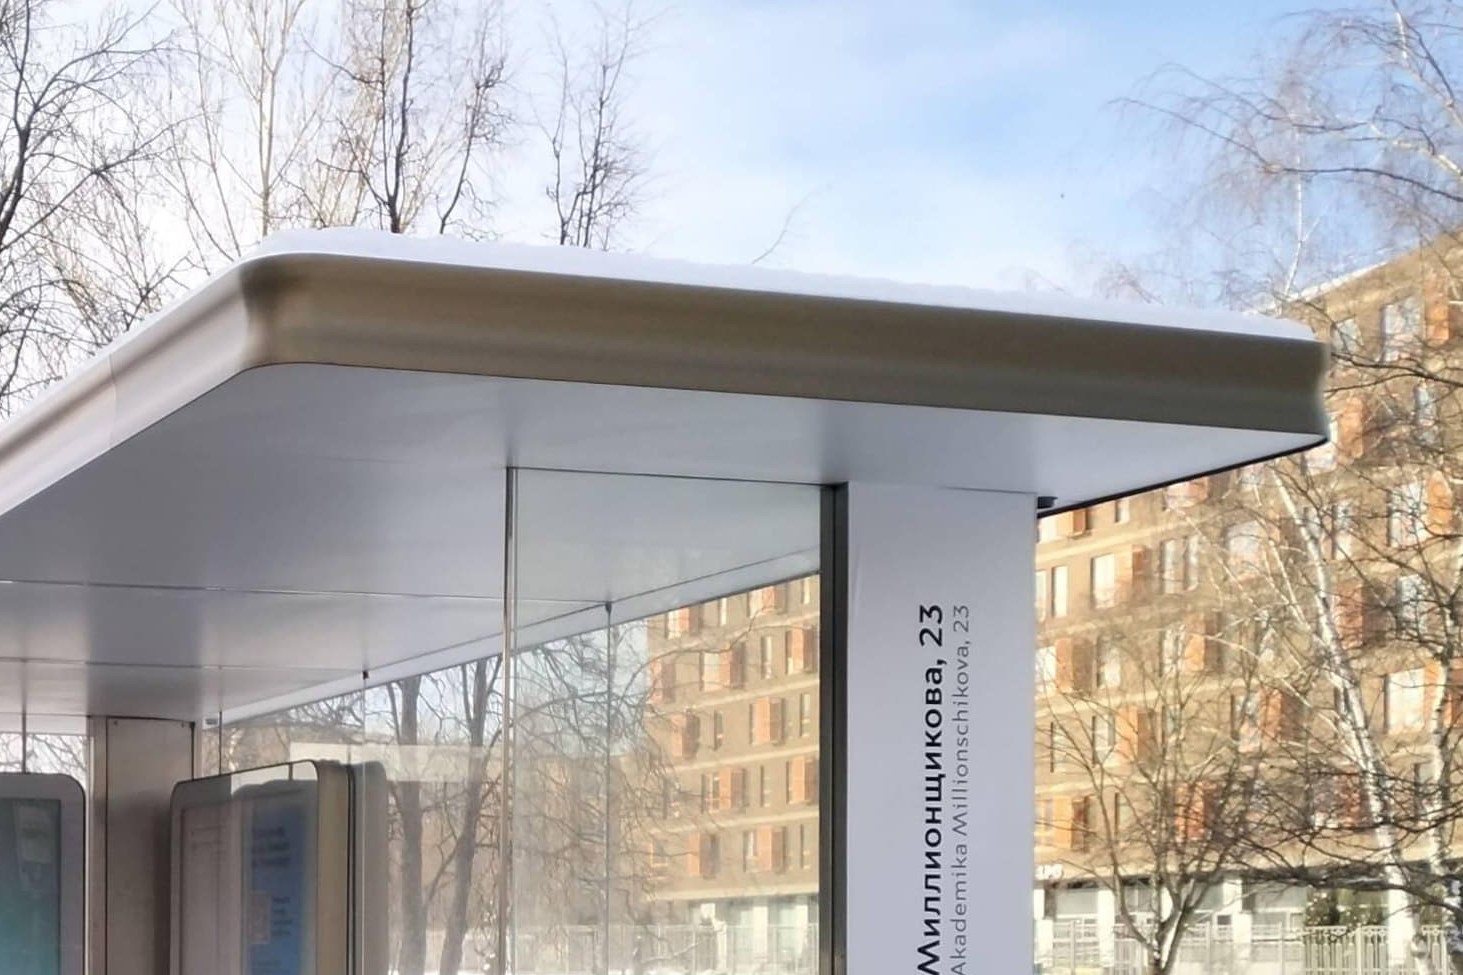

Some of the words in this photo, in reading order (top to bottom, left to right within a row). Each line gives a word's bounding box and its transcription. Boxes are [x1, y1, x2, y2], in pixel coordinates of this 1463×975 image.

[918, 604, 943, 647] 23
[952, 604, 970, 633] 23
[951, 640, 971, 837] Millionschikova,
[949, 843, 969, 975] Akademika
